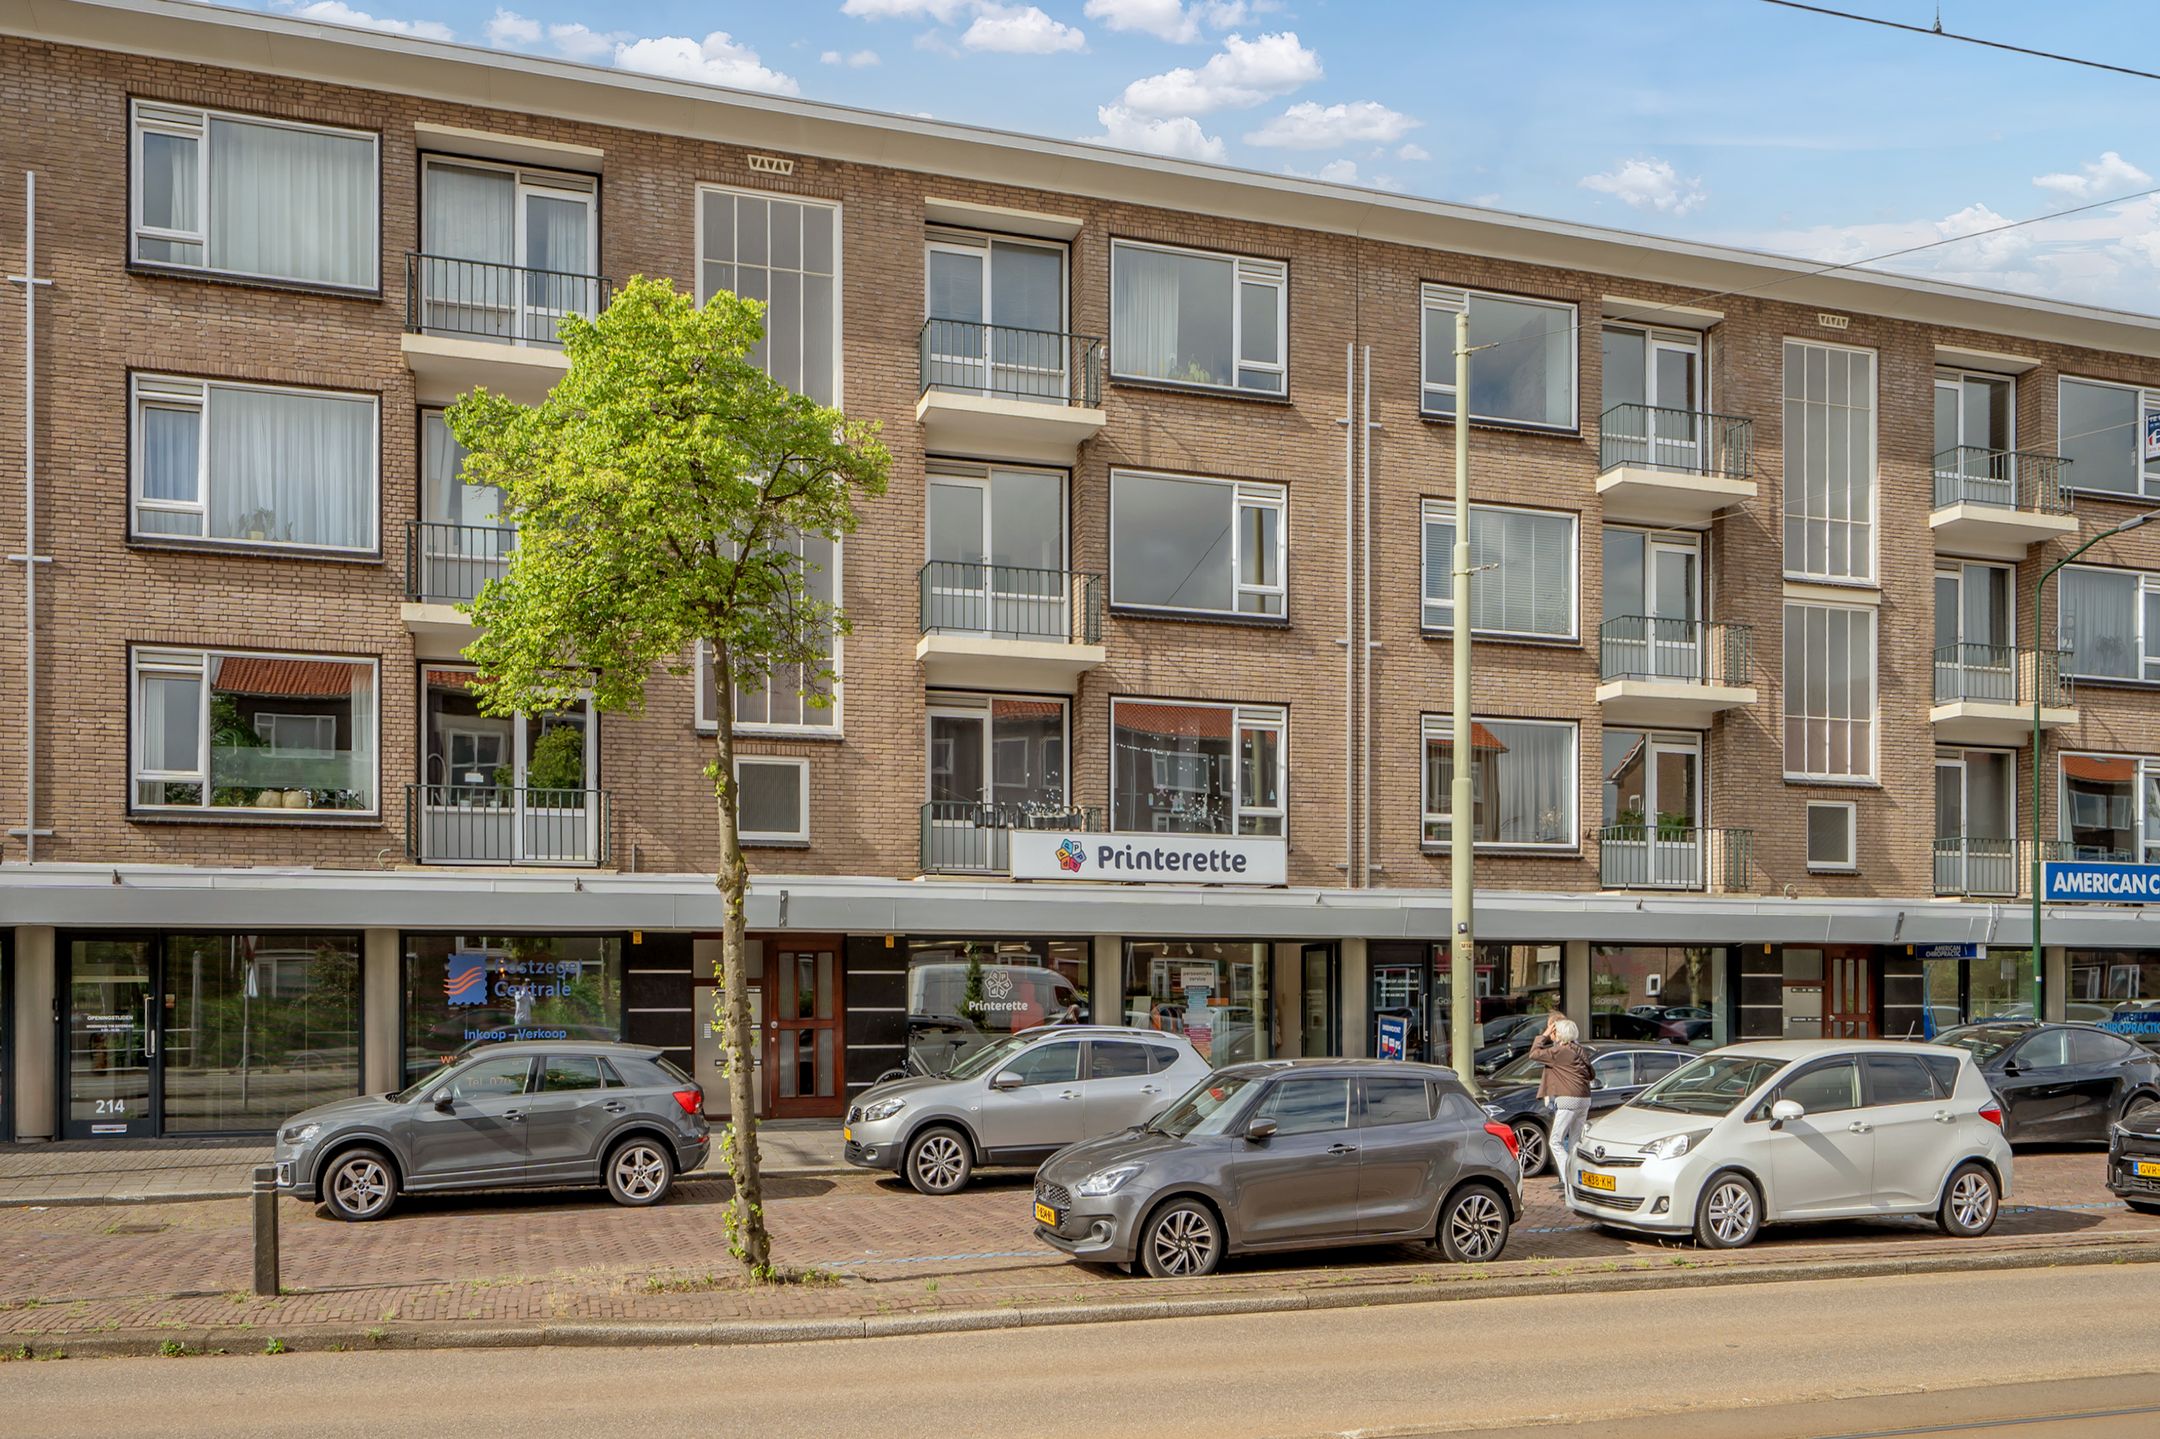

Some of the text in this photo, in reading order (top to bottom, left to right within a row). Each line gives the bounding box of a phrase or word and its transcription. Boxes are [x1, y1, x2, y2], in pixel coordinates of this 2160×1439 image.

[1098, 844, 1247, 873] Printerette
[2053, 871, 2147, 894] AMERICAN
[494, 980, 572, 997] Centrale
[968, 1000, 1029, 1011] Printerette
[464, 1029, 506, 1041] Inkoop
[517, 1029, 567, 1041] Verkoop
[95, 1099, 125, 1113] 214
